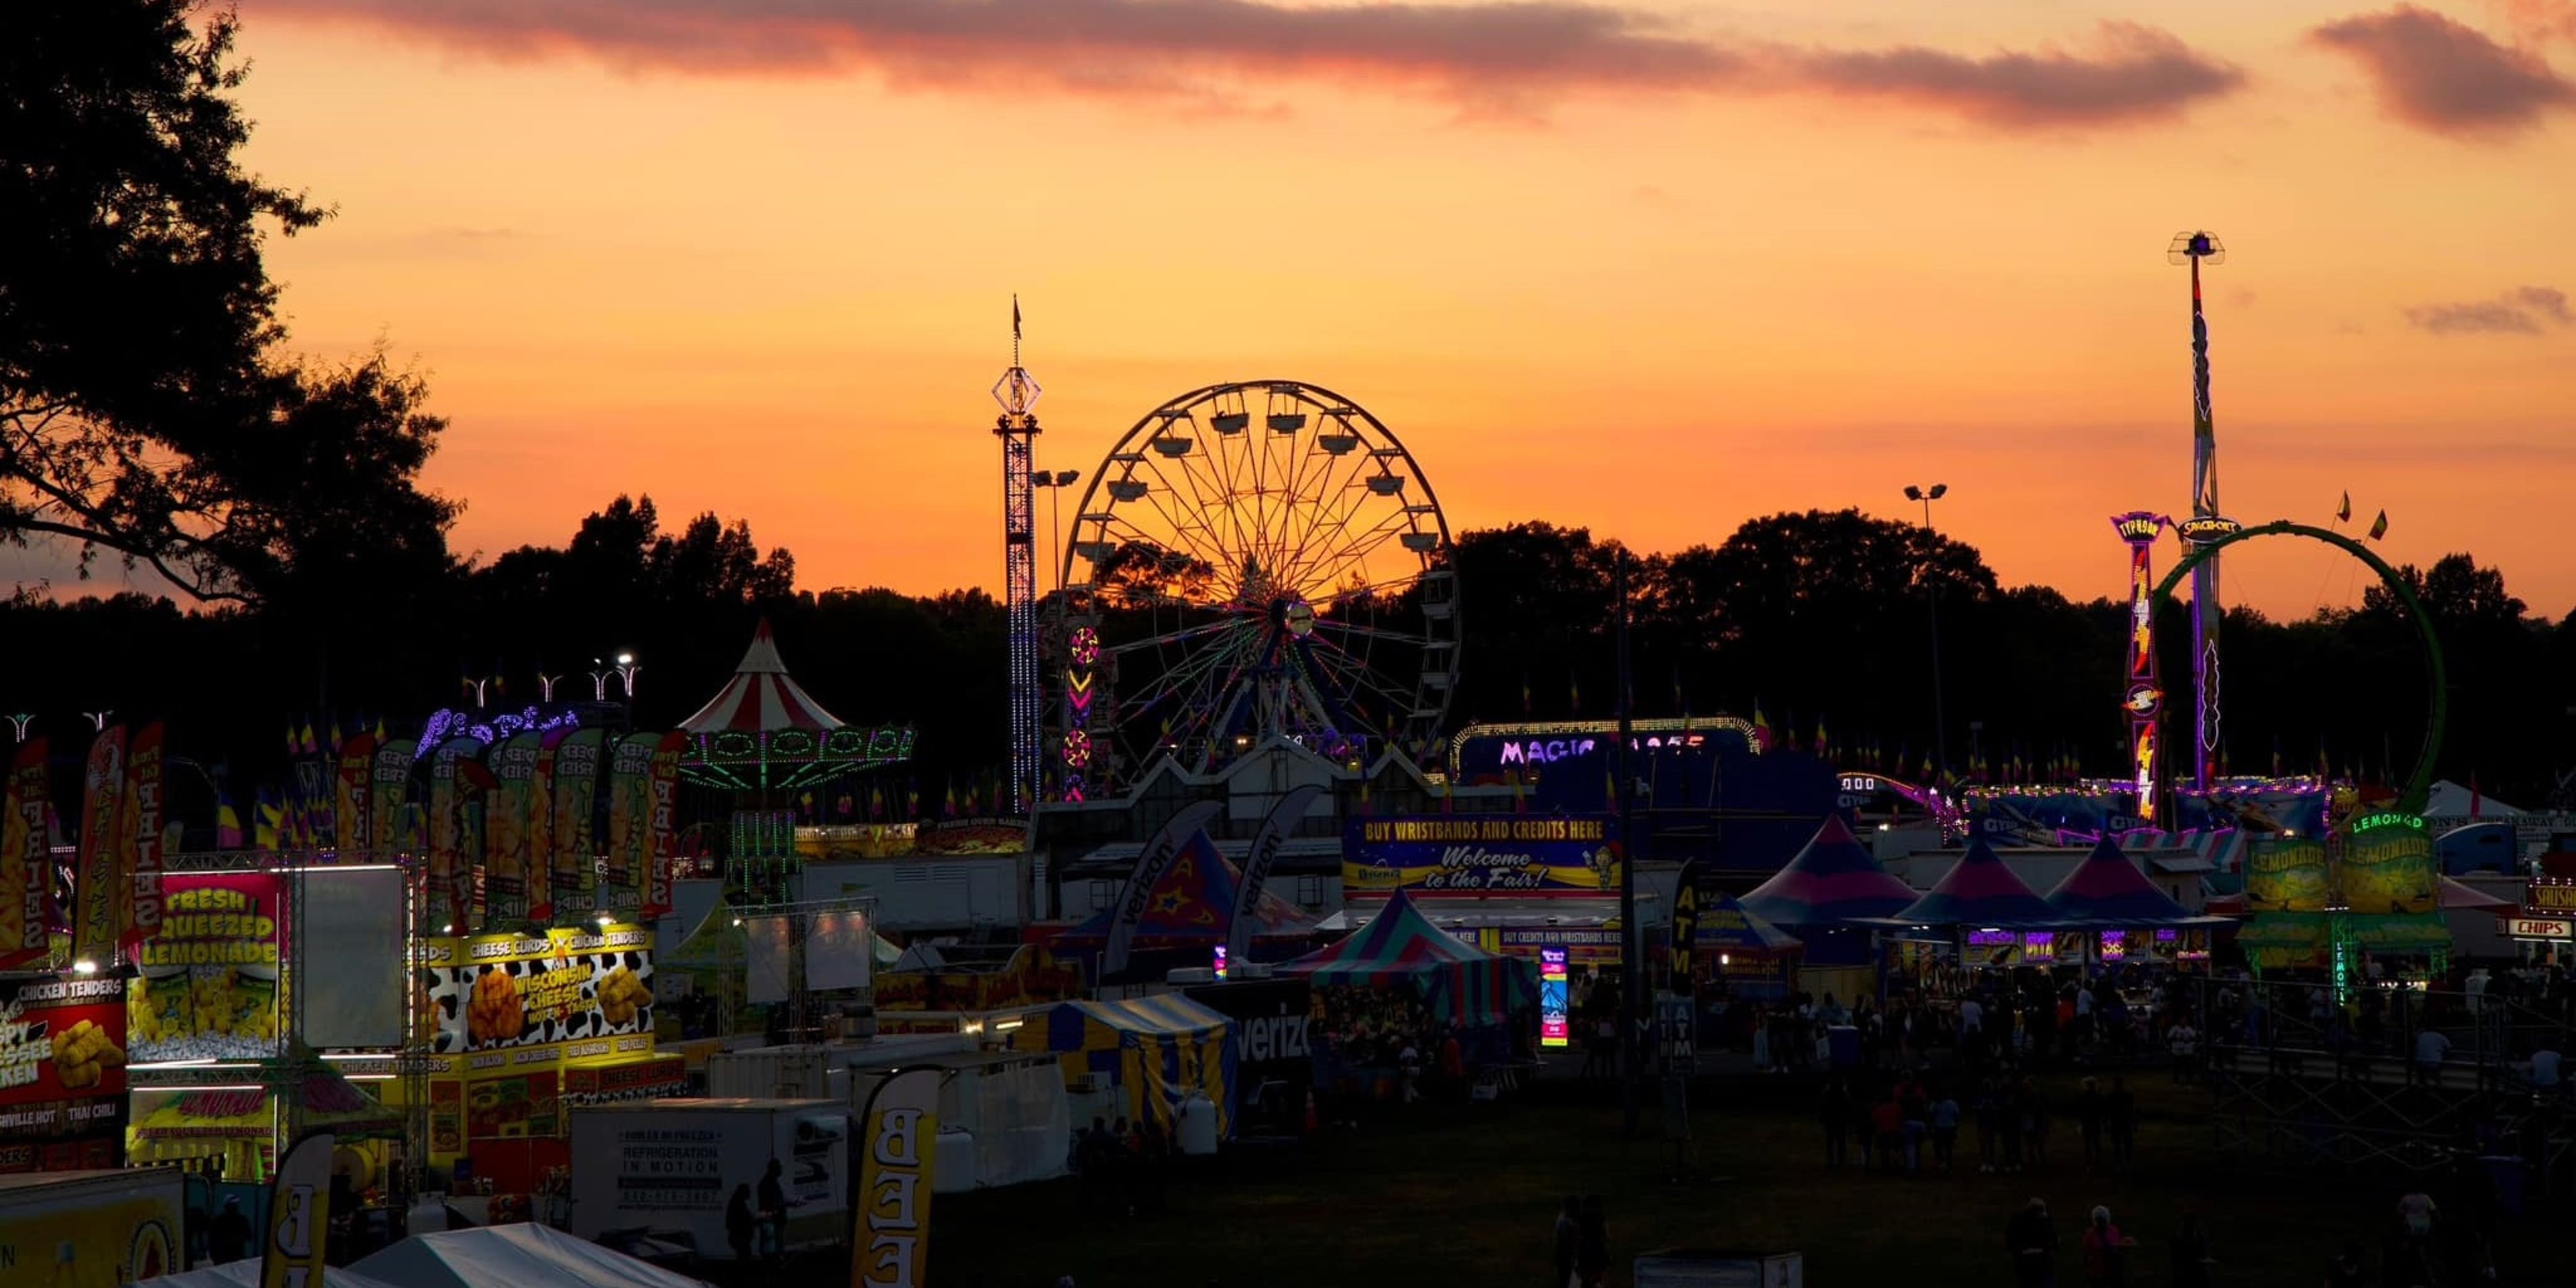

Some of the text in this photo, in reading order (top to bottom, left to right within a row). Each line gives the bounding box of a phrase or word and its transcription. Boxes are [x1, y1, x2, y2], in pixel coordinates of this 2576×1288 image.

[1364, 820, 1604, 843] BUY WRISTBANDS AND CREDITS HERE
[1441, 846, 1532, 869] Welcome
[2251, 845, 2326, 873] LEMONADE
[2346, 838, 2430, 866] LEMONADE
[1122, 843, 1175, 925] verizon
[1242, 834, 1283, 916] verizon
[1425, 868, 1549, 890] to the Fair!
[166, 887, 247, 913] FRESH
[161, 913, 275, 940] QUEEZED
[1670, 885, 1696, 975] ATM
[2518, 921, 2563, 934] CHIPS
[142, 941, 278, 966] LEMONADE
[472, 930, 646, 959] CHEESE CURDS CHICKEN TENDERS
[18, 979, 123, 1002] CHICKEN TENDERS
[513, 962, 592, 996] WISCONSIN
[529, 984, 580, 1011] CHEESE
[0, 1020, 32, 1046] PY
[1673, 1007, 1692, 1058] ATM
[0, 1037, 53, 1067] SSEE
[36, 1109, 56, 1125] HOT
[68, 1102, 117, 1122] THAI CHILI
[623, 1146, 718, 1159] REFRIGERATION
[623, 1161, 718, 1173] IN MOTION
